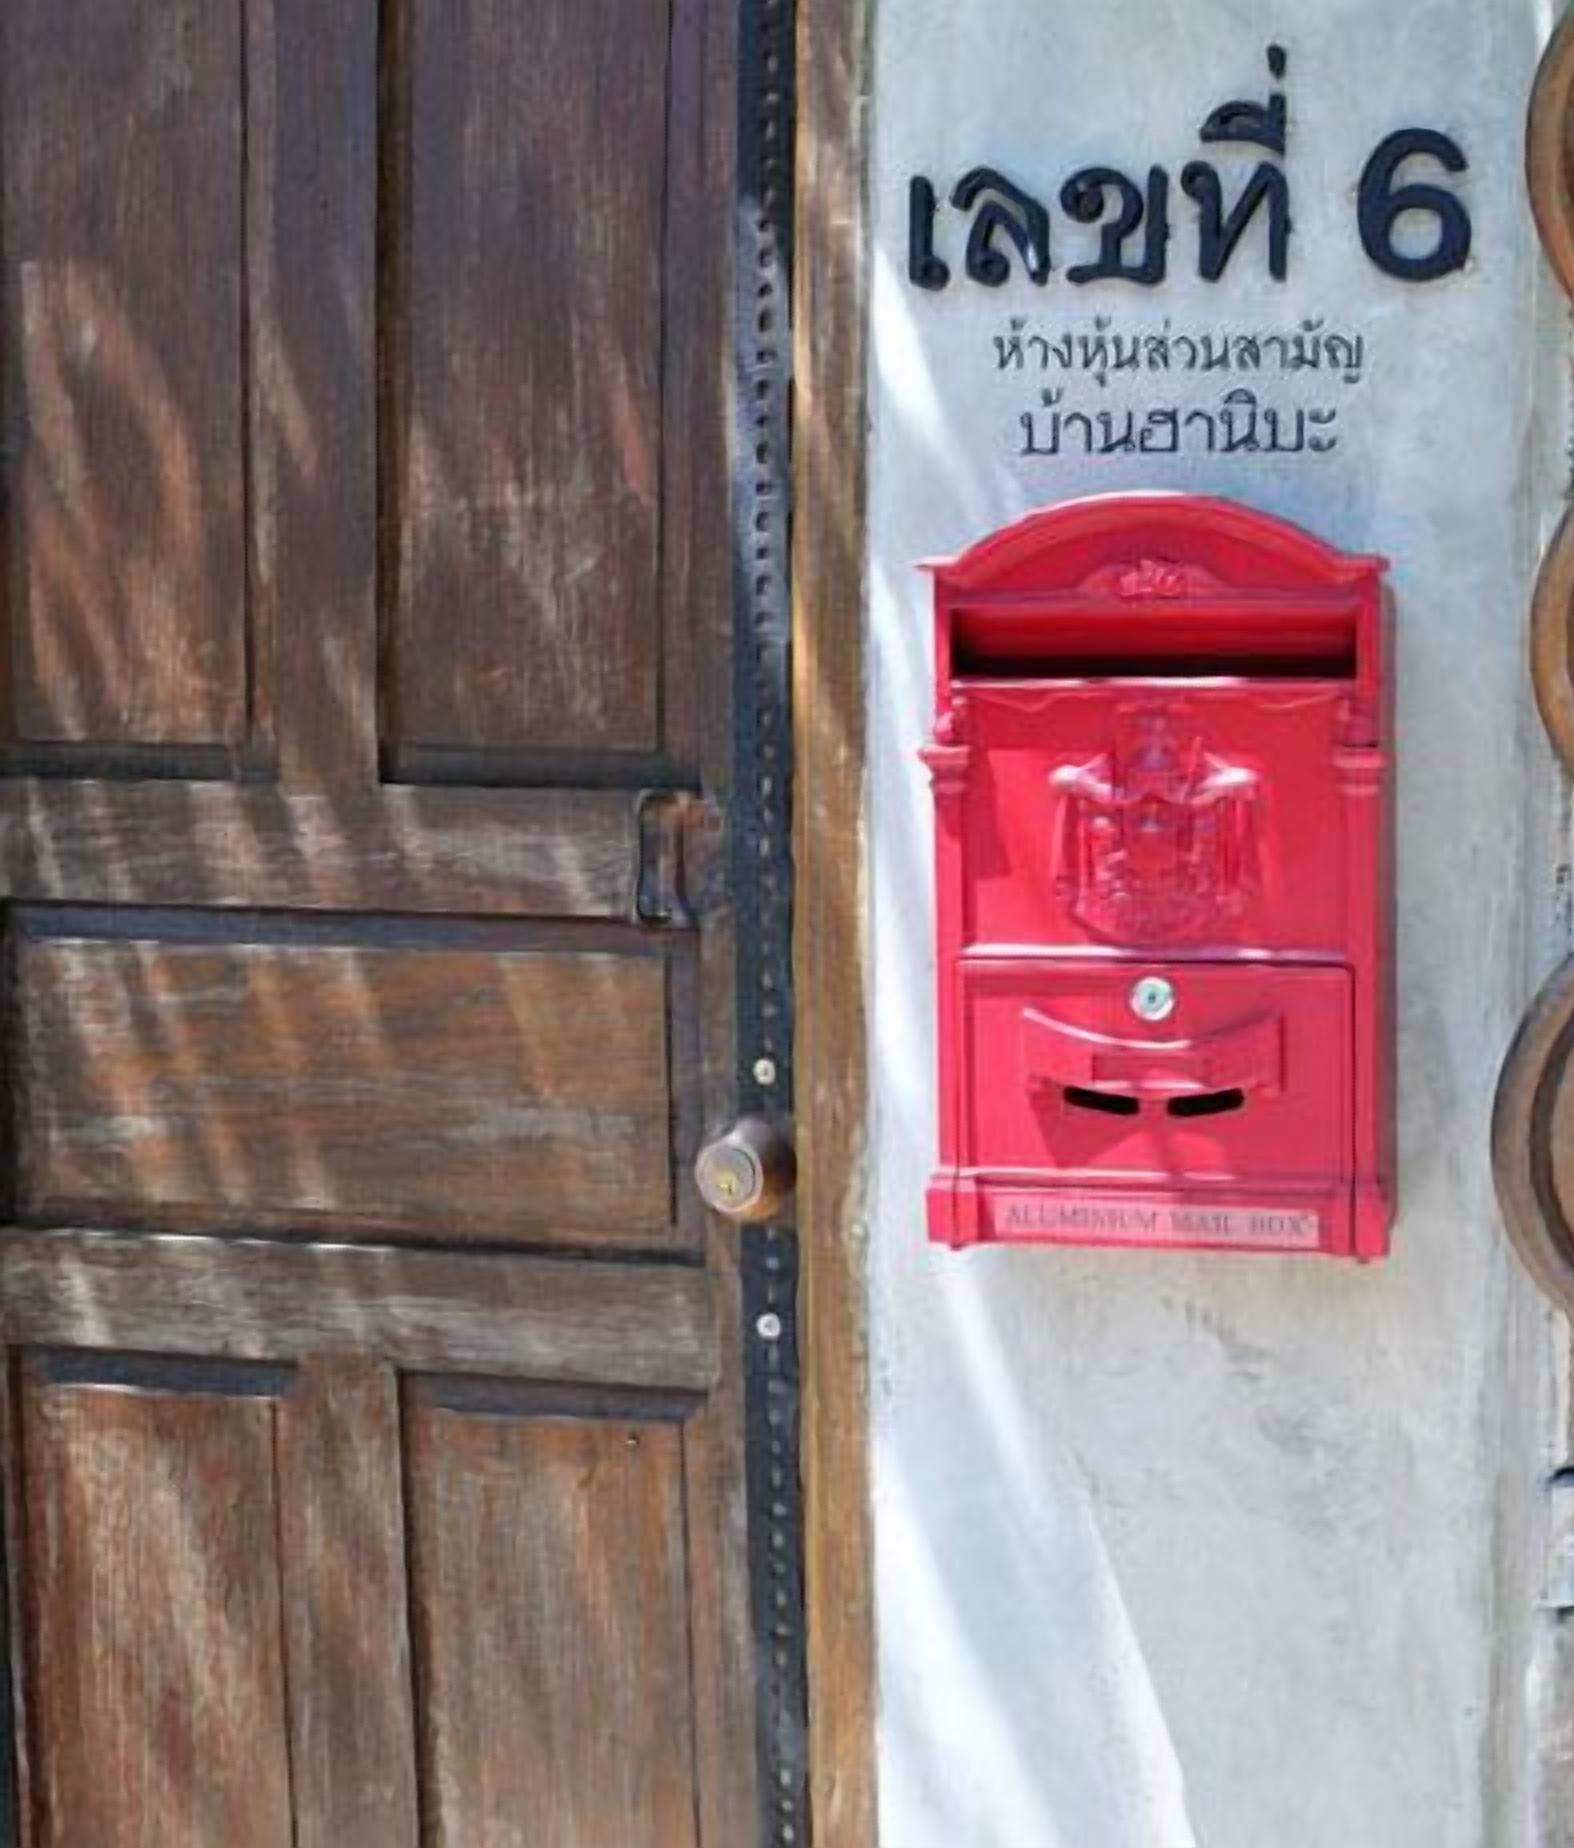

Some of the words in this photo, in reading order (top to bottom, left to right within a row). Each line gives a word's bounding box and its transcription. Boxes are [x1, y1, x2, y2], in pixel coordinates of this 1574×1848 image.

[907, 44, 1291, 290] เลขที่
[1356, 127, 1473, 282] 6
[992, 316, 1364, 384] ห้างหุ้นส่วนสามัญ
[1019, 387, 1337, 455] บ้านฮานิบะ
